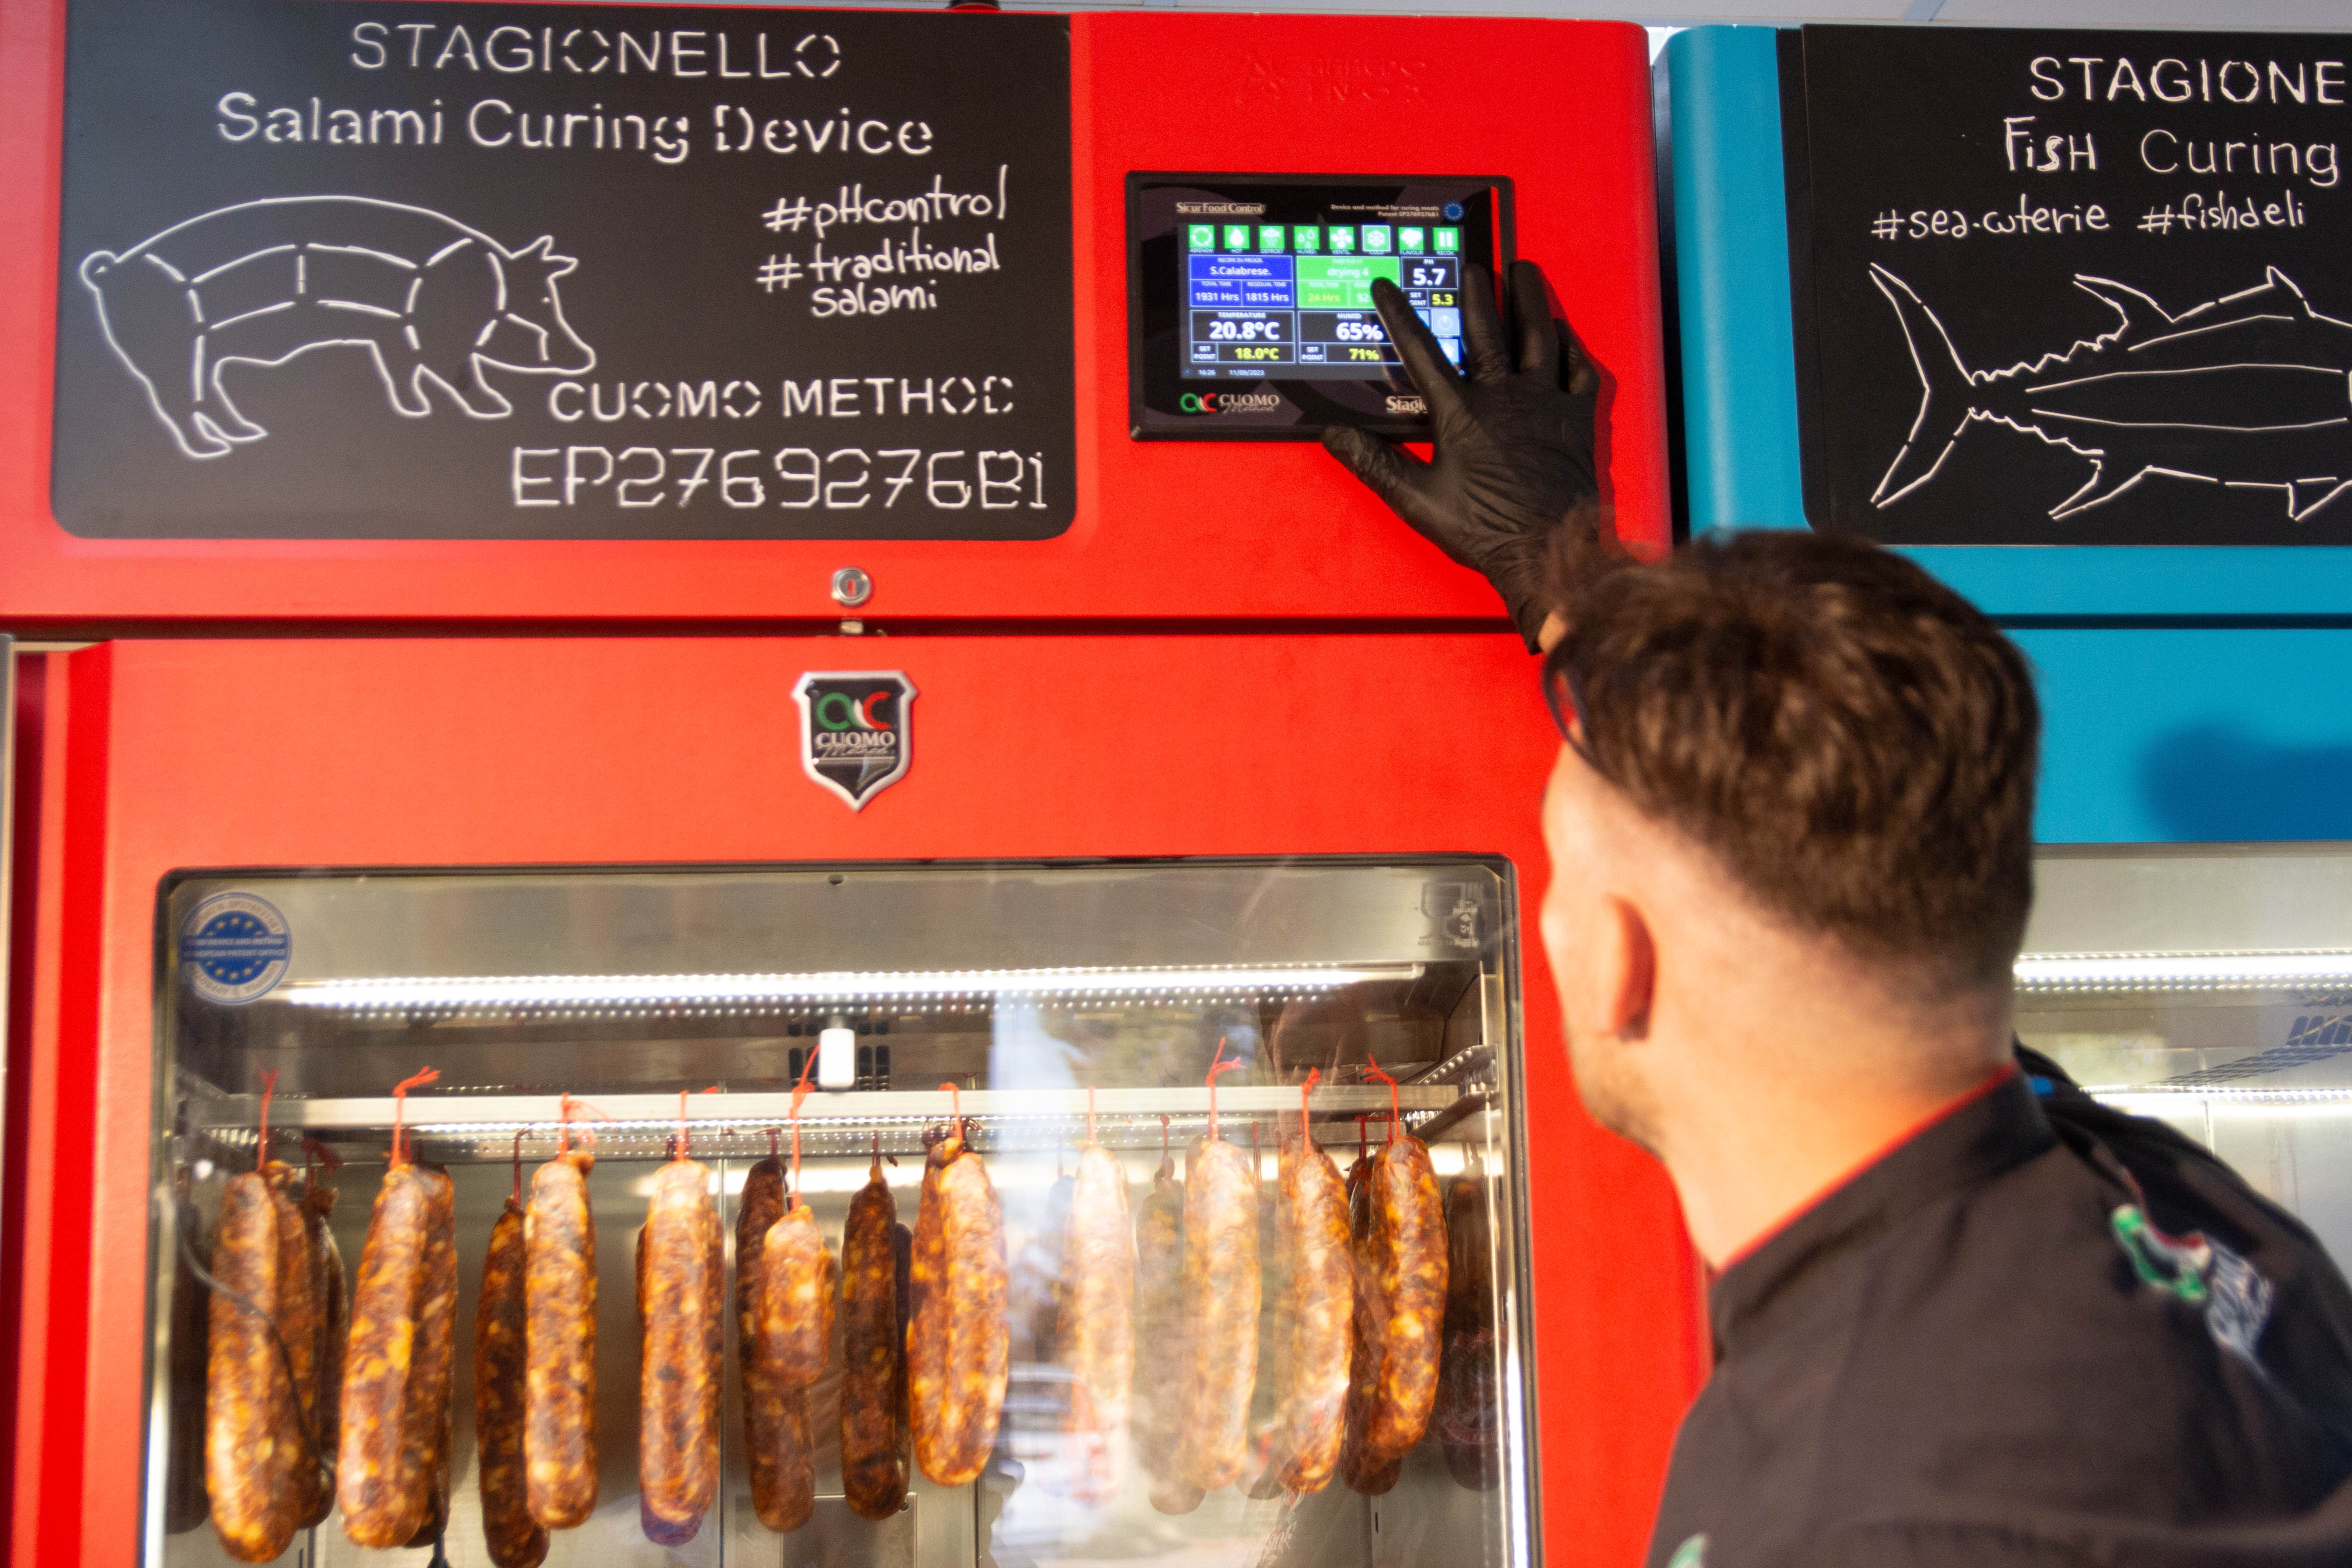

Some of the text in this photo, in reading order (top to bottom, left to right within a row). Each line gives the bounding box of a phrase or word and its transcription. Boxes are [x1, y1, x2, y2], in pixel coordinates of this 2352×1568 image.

[352, 22, 840, 78] STAGIONELLO
[2030, 56, 2345, 104] STAGIONE
[217, 91, 933, 164] Salami Curing Device
[2141, 130, 2338, 186] Curing
[1176, 202, 1262, 214] Sicur Food Control
[2137, 190, 2304, 234] #fishdeli
[1210, 266, 1272, 276] S.Calabrese.
[1327, 267, 1369, 278] drying 4
[1412, 268, 1446, 286] 5.7
[812, 280, 938, 317] salami
[1196, 292, 1240, 302] 1931 Hrs
[1246, 293, 1289, 302] 1815 Hrs
[1308, 293, 1340, 302] 24 Hrs
[1432, 294, 1454, 306] 5.3
[1209, 320, 1280, 340] 20.8°C
[1336, 322, 1384, 340] 65%
[1234, 347, 1280, 360] 18.0°C
[1349, 348, 1380, 360] 71%
[548, 380, 762, 422] CUOMO
[1218, 394, 1280, 406] CUOMO
[814, 732, 896, 747] CUOMO
